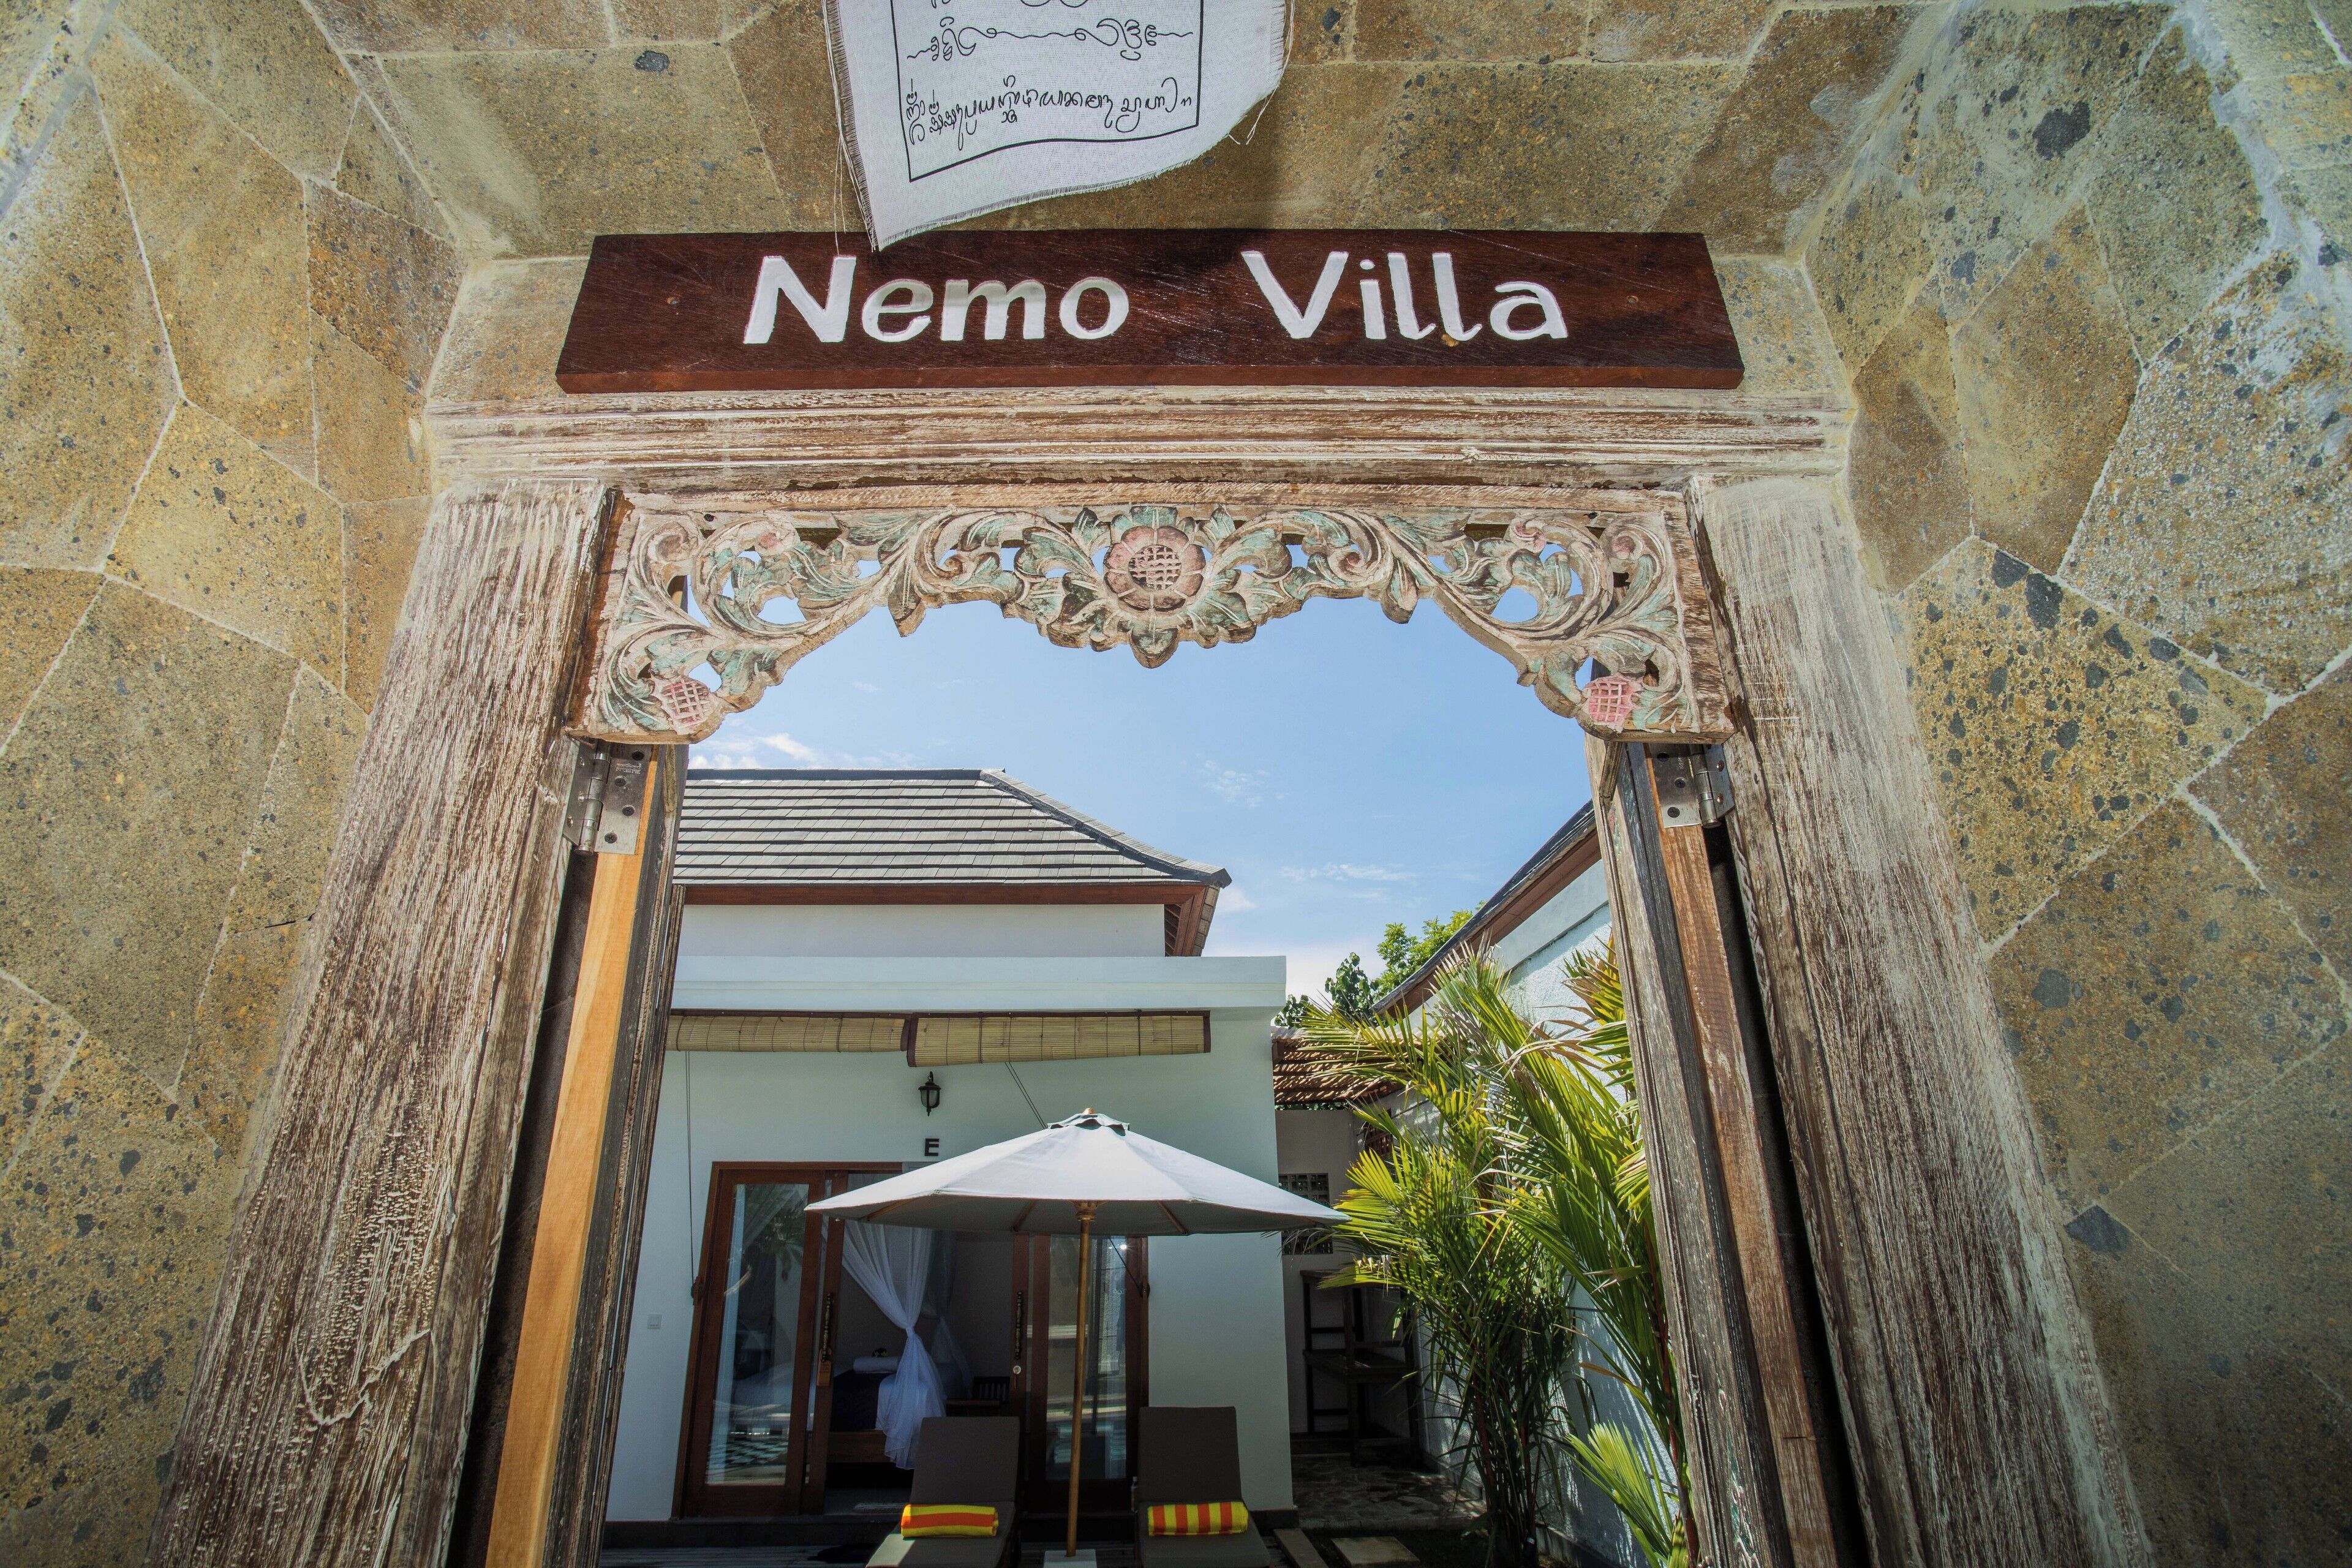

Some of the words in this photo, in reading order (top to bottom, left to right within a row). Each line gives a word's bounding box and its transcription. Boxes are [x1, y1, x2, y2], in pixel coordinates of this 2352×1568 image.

[743, 255, 1129, 344] Nemo
[1241, 251, 1568, 341] Villa
[924, 1138, 940, 1156] E
